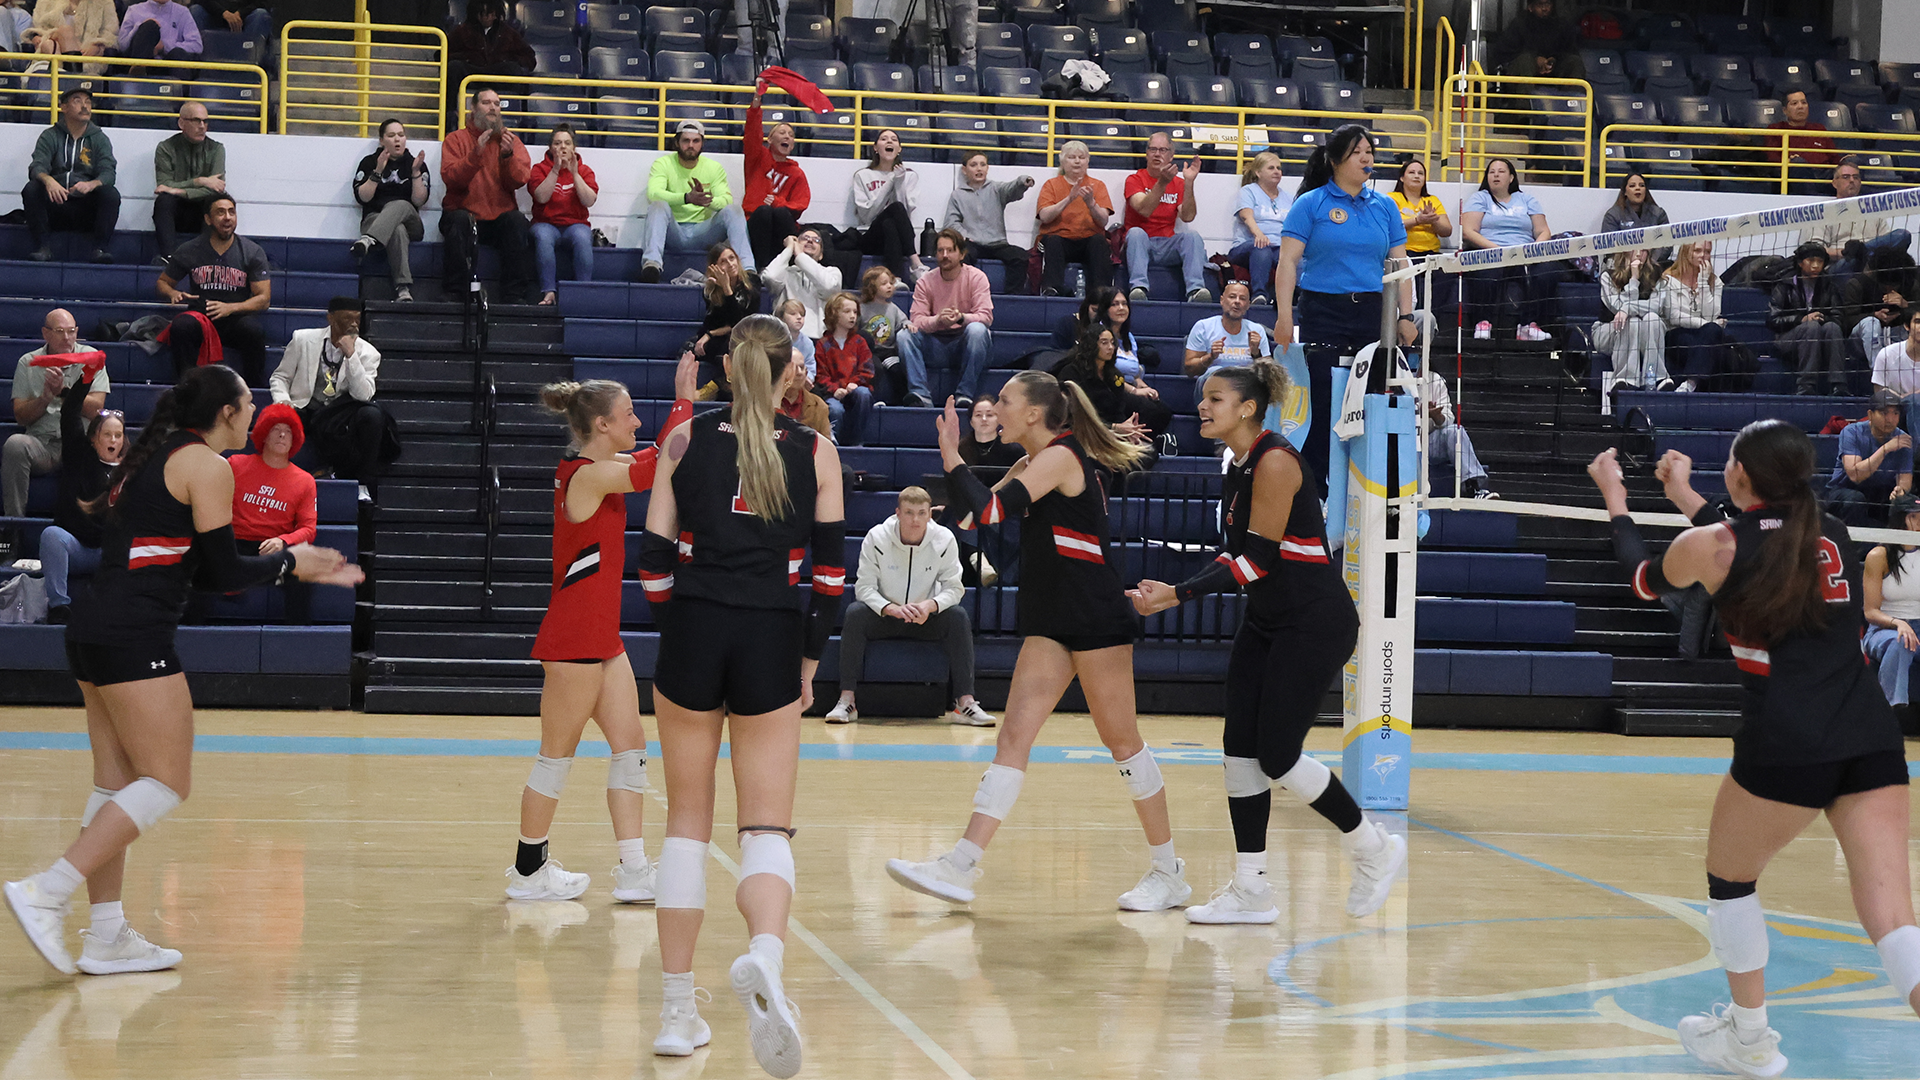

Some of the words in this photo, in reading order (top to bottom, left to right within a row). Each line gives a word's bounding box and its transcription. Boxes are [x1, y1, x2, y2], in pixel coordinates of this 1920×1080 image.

[1758, 204, 1825, 227] CHAMPIONSHIP
[1670, 217, 1728, 239] CHAMPIONSHIP
[1523, 239, 1570, 258] CHAMPIONSHIP
[1593, 229, 1644, 250] CHAMPIONSHIP
[1460, 249, 1503, 266] CHAMPIONSHIP
[200, 283, 238, 292] UNIVERSITY
[258, 484, 277, 497] SFU
[243, 492, 288, 512] VOLLEYBALL
[1760, 519, 1783, 530] SAIN
[1345, 494, 1361, 717] SHRKS
[1381, 641, 1394, 684] sports
[1380, 686, 1393, 740] imports
